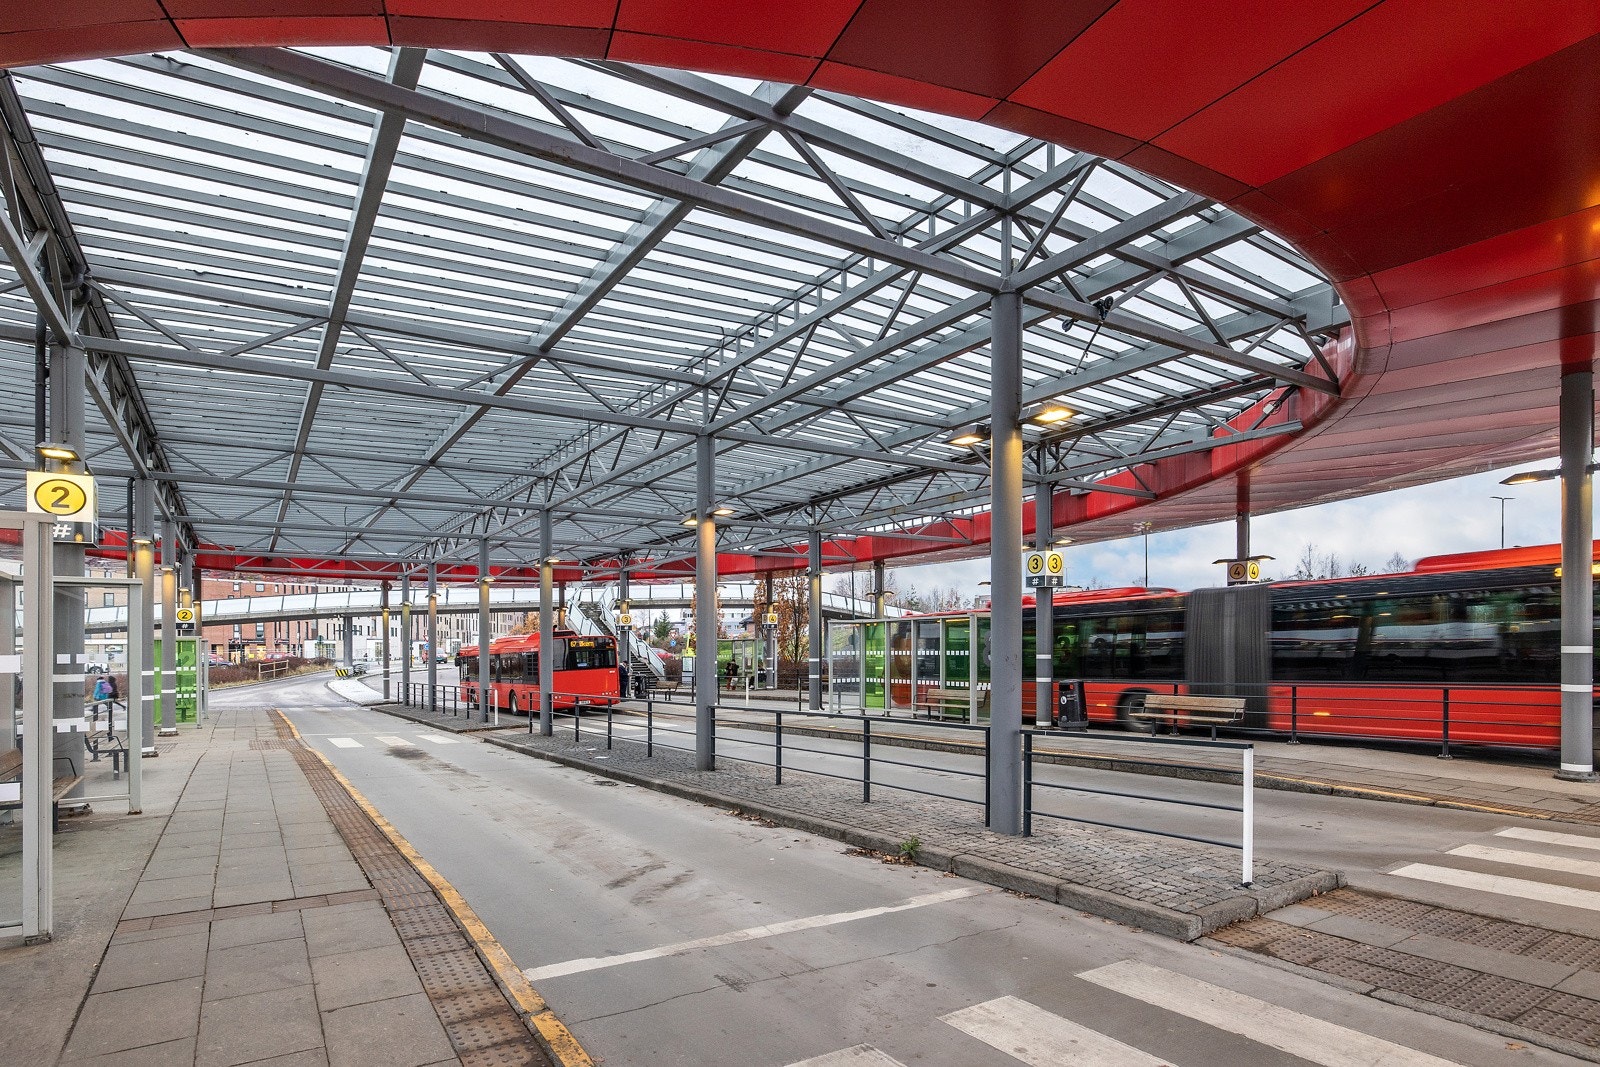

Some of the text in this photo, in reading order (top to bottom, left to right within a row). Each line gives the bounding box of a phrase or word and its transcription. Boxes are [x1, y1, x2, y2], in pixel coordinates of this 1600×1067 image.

[51, 486, 70, 508] 2
[1032, 558, 1039, 570] 3
[1052, 557, 1058, 569] 3
[1234, 566, 1241, 576] 4
[1251, 566, 1256, 576] 4
[181, 611, 188, 620] 2
